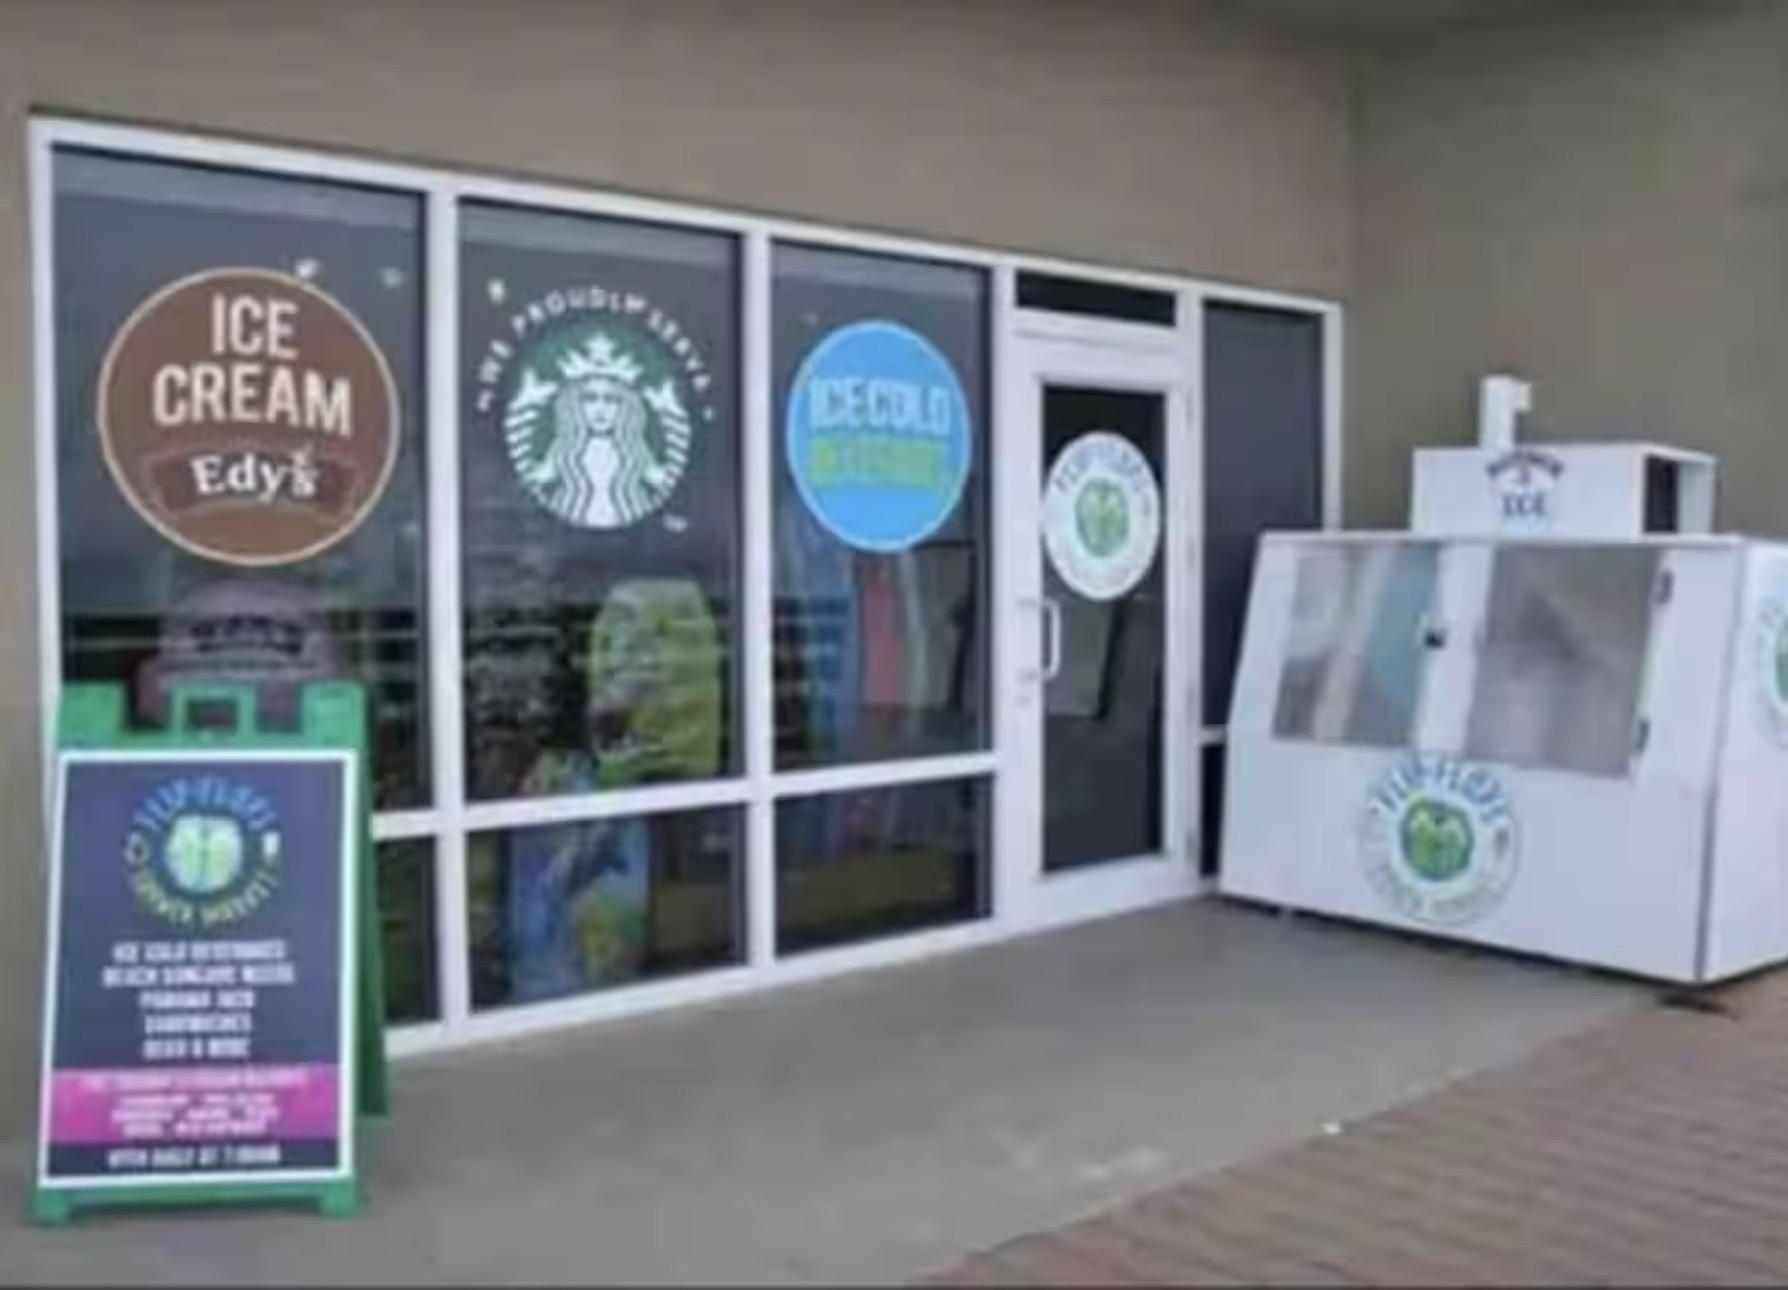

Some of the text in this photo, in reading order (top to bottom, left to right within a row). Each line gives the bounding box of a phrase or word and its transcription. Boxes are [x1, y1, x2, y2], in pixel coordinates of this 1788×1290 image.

[211, 293, 299, 360] ICE
[511, 285, 648, 339] PROUDLY
[153, 361, 353, 438] CREAM
[808, 374, 951, 437] ICE COLD
